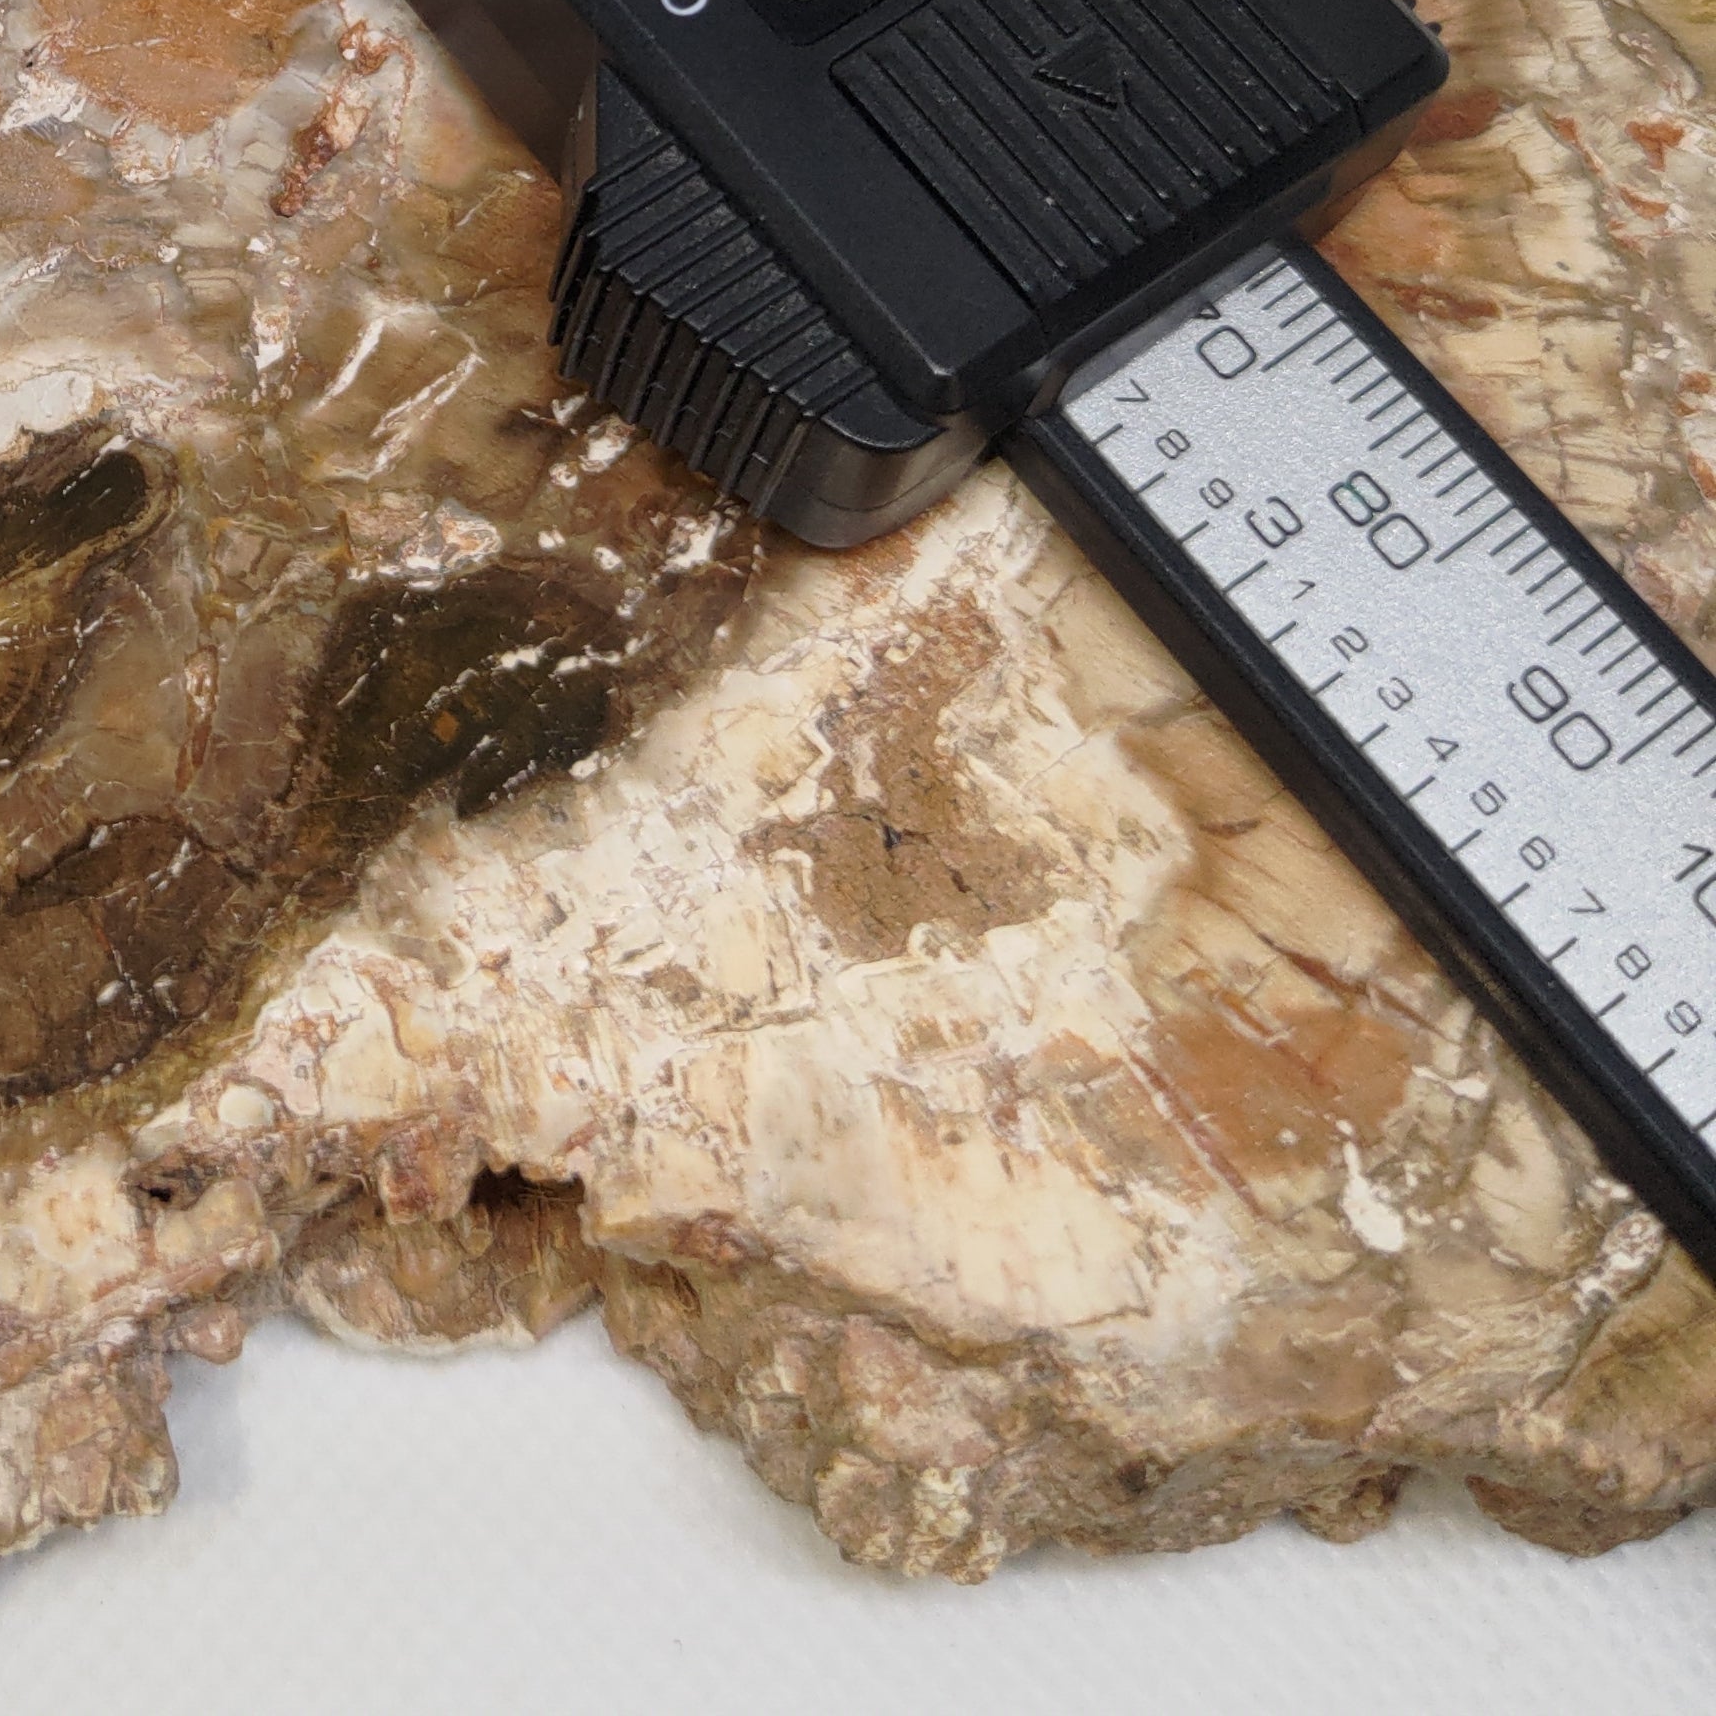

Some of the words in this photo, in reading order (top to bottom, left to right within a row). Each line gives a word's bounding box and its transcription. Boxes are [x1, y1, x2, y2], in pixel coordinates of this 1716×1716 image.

[1114, 378, 1151, 404] 7
[1154, 428, 1192, 461] 8
[1199, 477, 1236, 511] 9
[1244, 495, 1305, 551] 3
[1291, 579, 1318, 602] 1
[1330, 625, 1370, 662] 2
[1376, 675, 1415, 712] 3
[1424, 735, 1461, 764] 4
[1470, 779, 1509, 818] 5
[1519, 834, 1557, 873] 6
[1568, 887, 1607, 915] 7
[1614, 942, 1654, 982] 8
[1664, 999, 1704, 1038] 9
[1327, 470, 1434, 572] 80
[1506, 664, 1615, 774] 90
